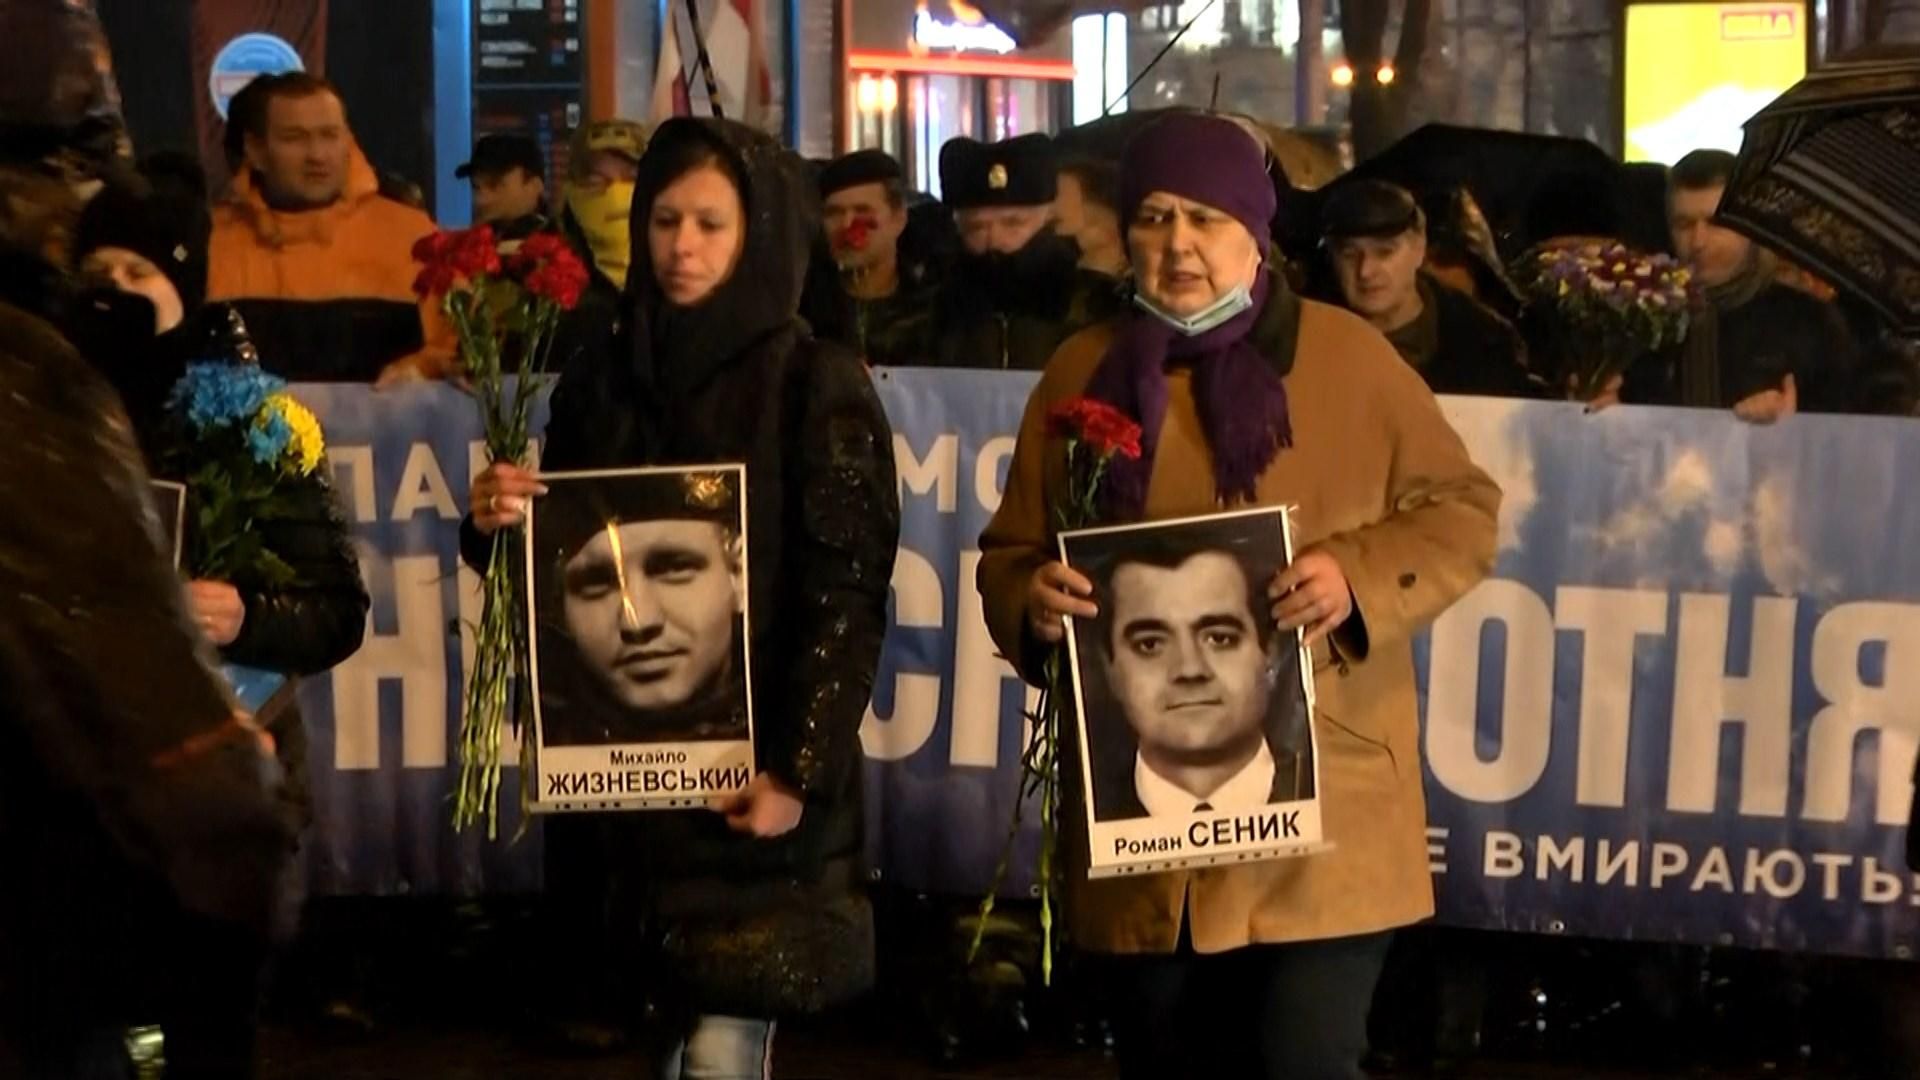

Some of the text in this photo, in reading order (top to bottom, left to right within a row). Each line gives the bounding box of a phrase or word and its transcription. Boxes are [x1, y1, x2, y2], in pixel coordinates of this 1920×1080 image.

[1426, 577, 1920, 825] ОТНЯ
[610, 751, 687, 766] Михайло
[548, 763, 749, 796] ЖИЗНЕВСЬКИЙ
[1114, 811, 1301, 856] Роман СЕНИК
